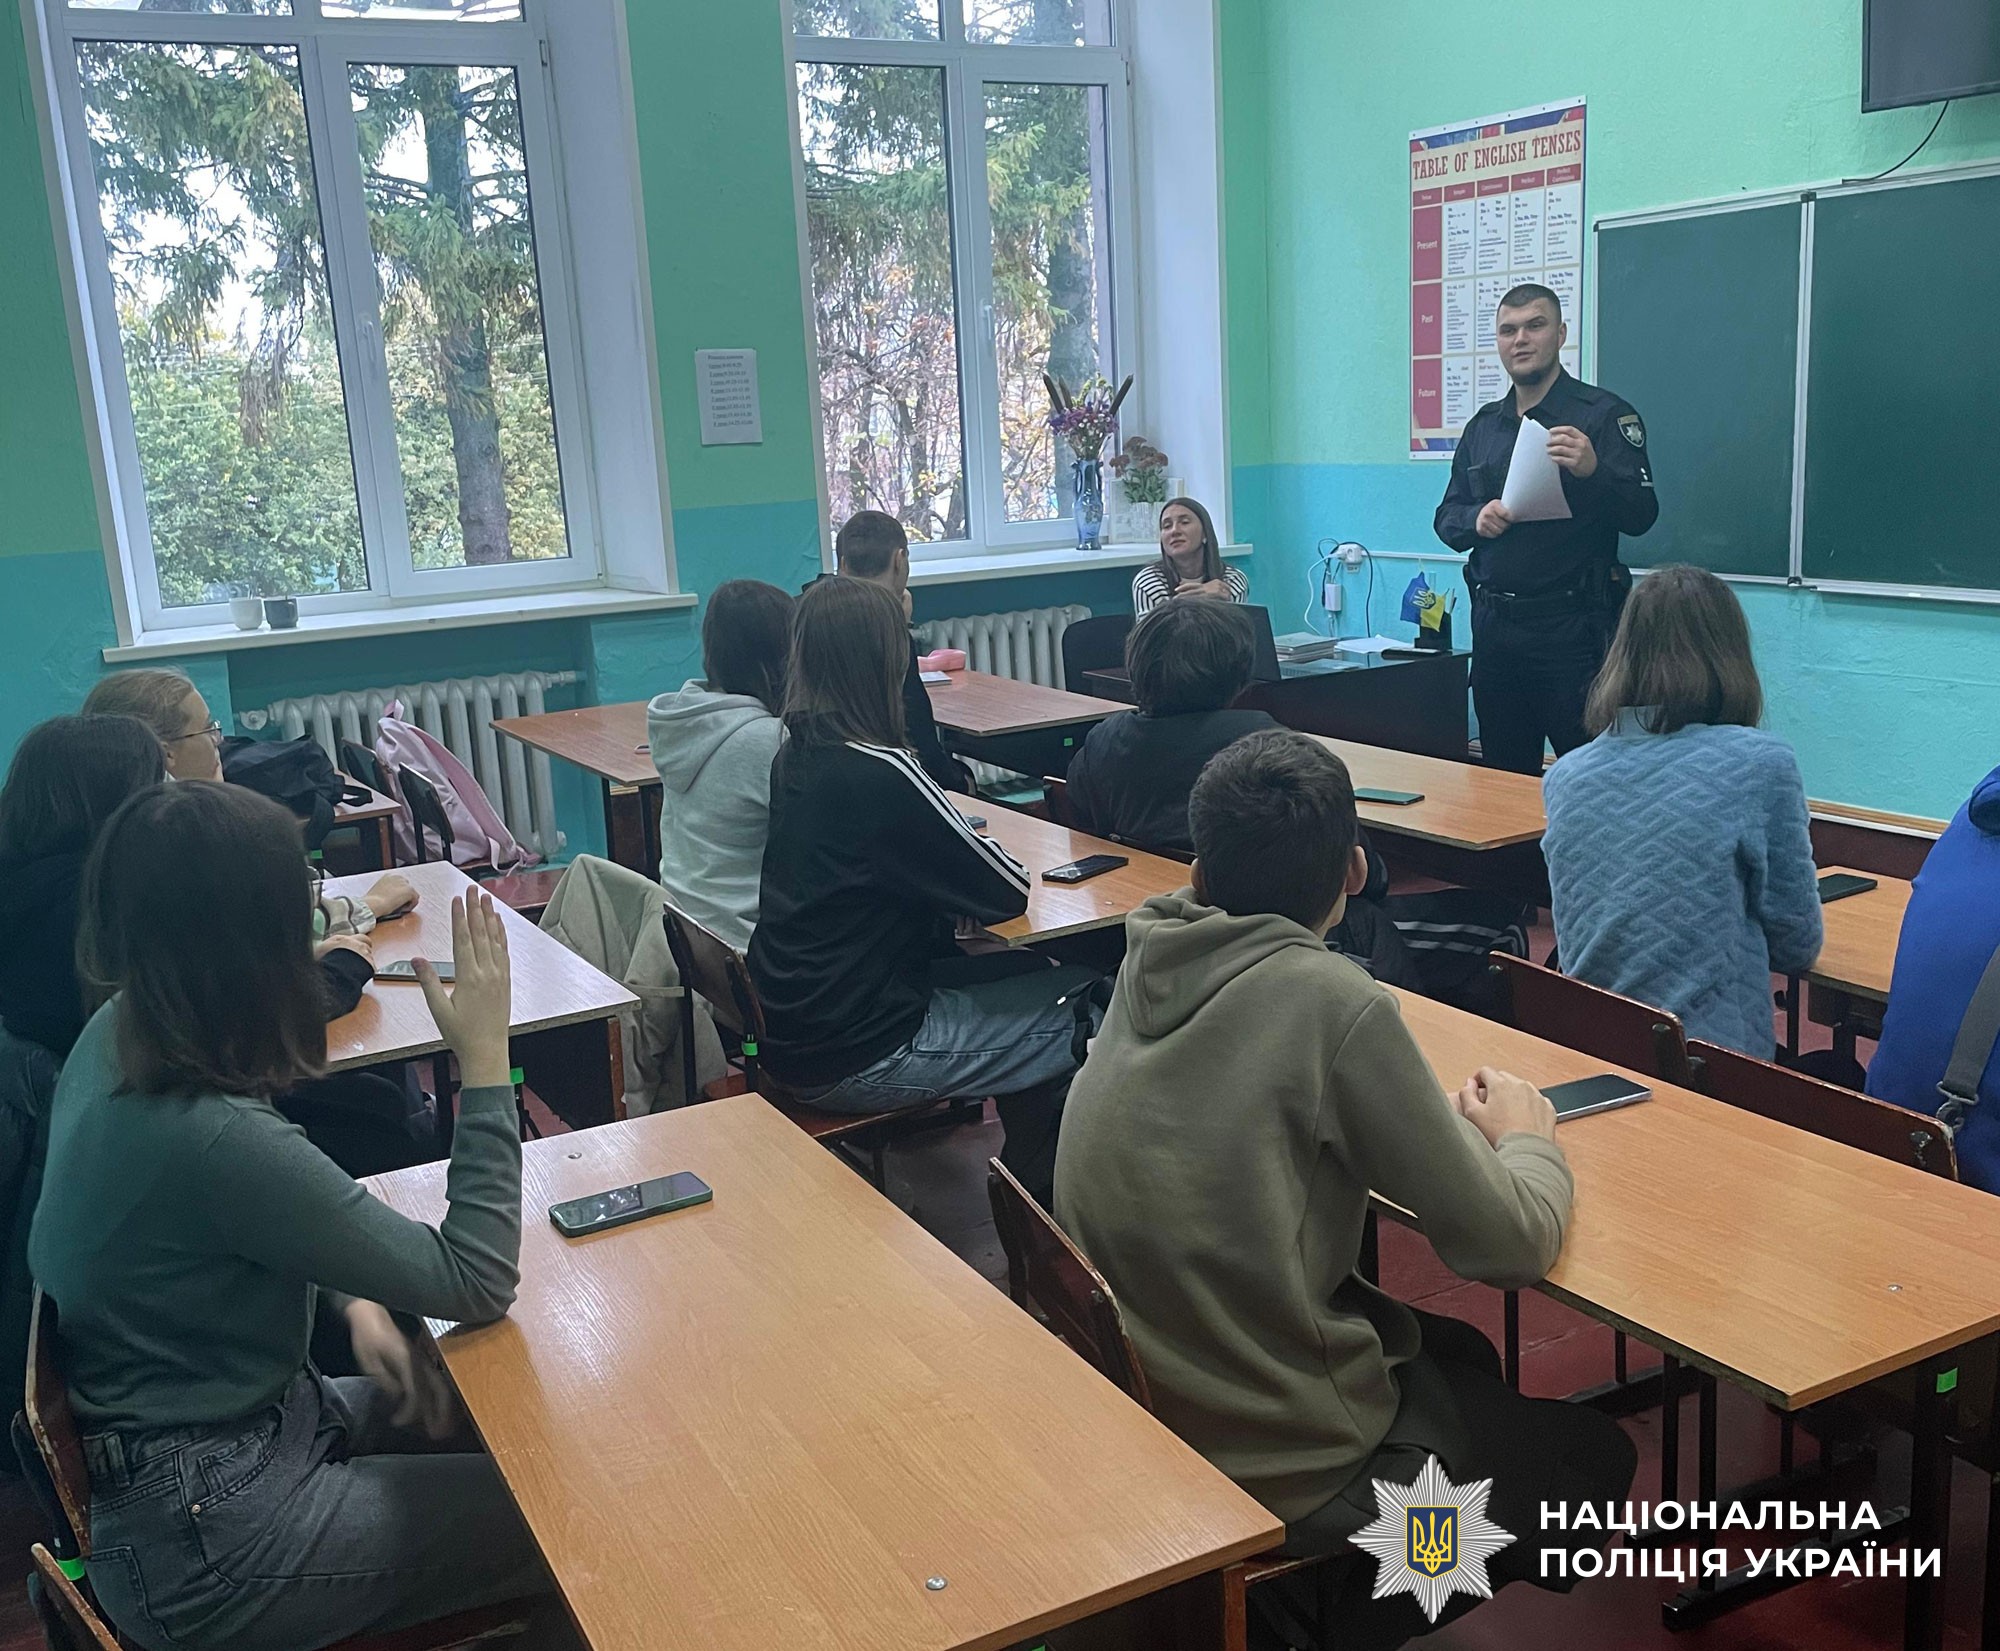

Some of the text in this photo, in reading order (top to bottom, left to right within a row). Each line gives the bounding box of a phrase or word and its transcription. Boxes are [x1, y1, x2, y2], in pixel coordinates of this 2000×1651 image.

[1413, 131, 1580, 180] TABLE OF ENGLISH TENSES
[1416, 240, 1438, 251] Present
[1421, 314, 1433, 324] Past
[1418, 388, 1436, 398] Future
